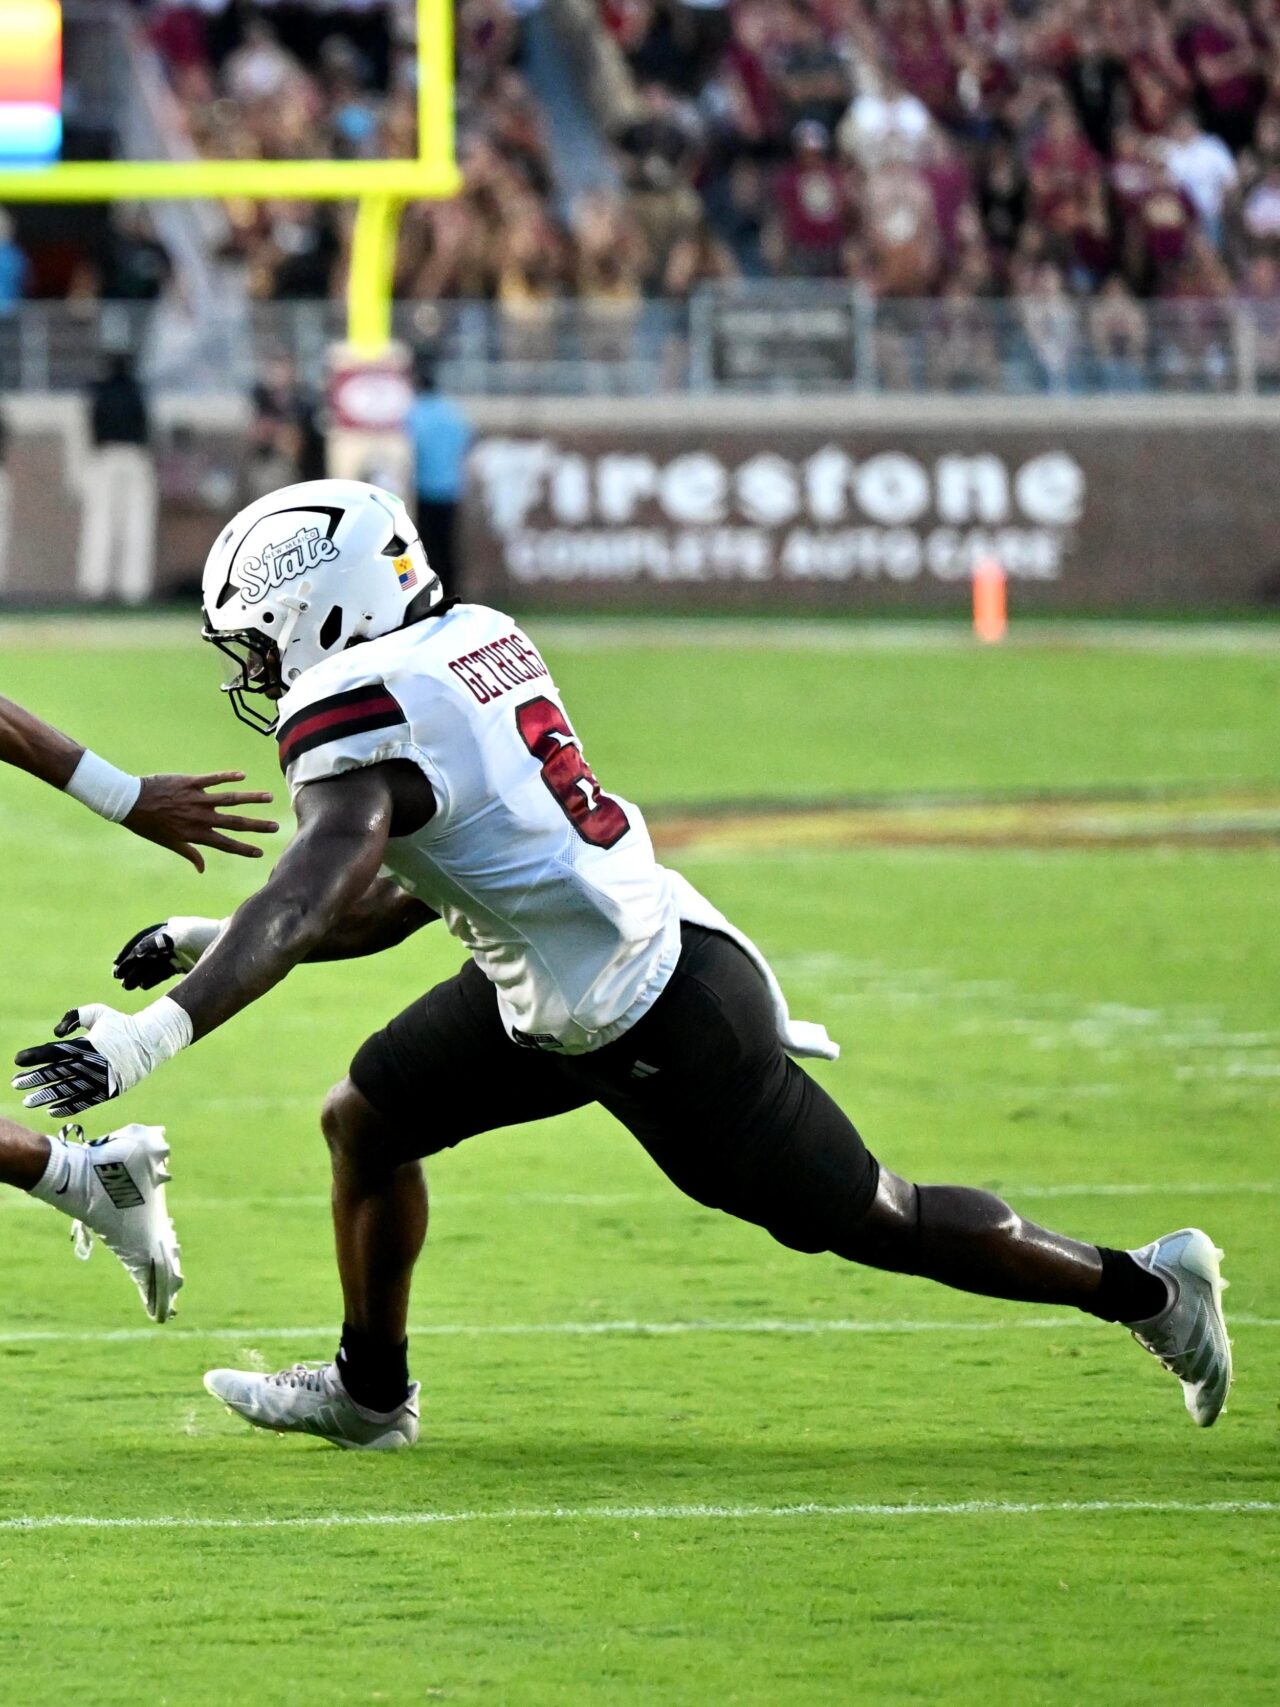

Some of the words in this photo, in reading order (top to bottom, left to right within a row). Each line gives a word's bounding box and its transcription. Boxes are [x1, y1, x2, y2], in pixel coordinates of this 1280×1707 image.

[470, 438, 1086, 530] Firestone
[237, 528, 340, 604] State
[265, 548, 282, 559] NEW
[285, 531, 316, 549] MEXICO
[781, 527, 923, 581] AUTO
[448, 634, 548, 704] GETHERS
[94, 1161, 145, 1209] NIKE
